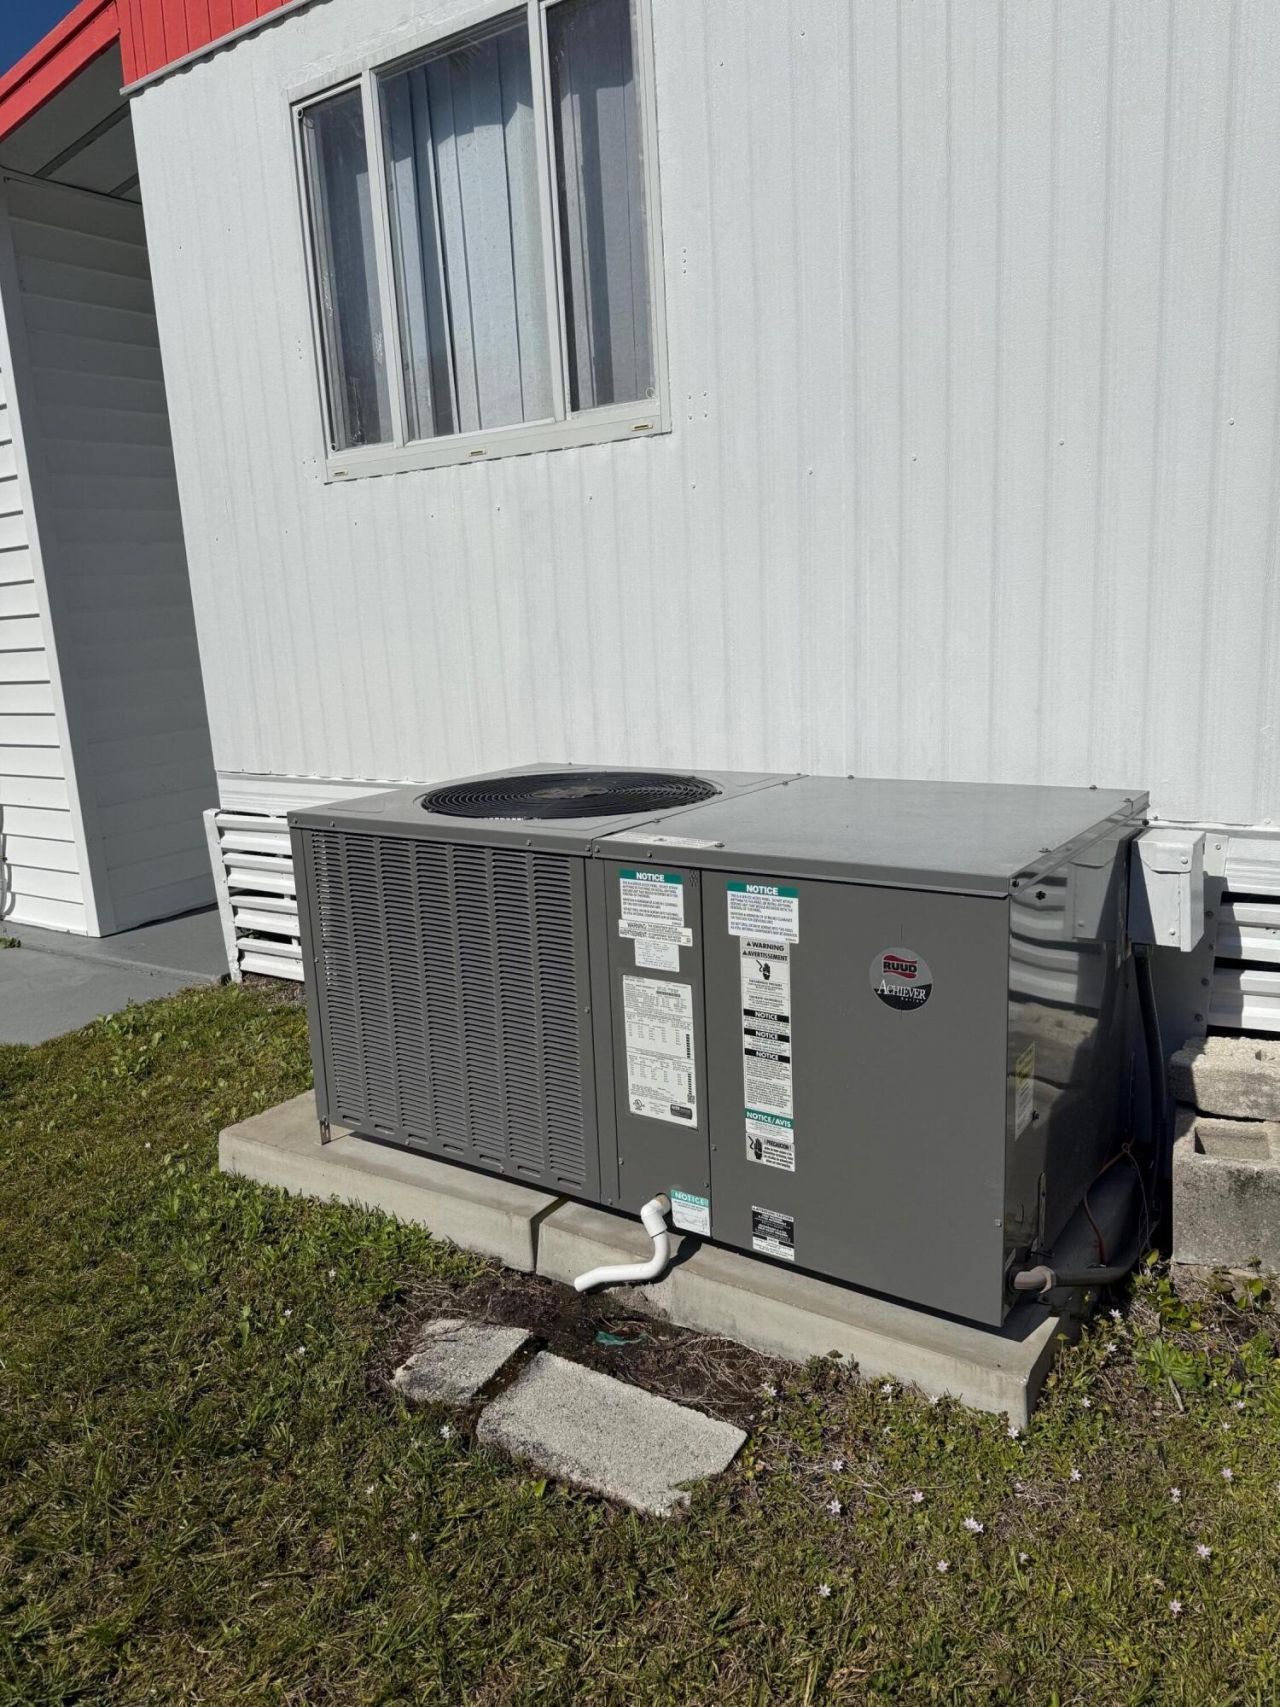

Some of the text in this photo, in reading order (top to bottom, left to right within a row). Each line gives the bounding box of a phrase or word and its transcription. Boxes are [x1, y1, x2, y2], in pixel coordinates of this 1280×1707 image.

[636, 872, 665, 882] NOTICE
[746, 884, 779, 895] NOTICE
[752, 941, 785, 952] WARNING
[883, 961, 918, 973] RUUD
[755, 1011, 778, 1021] NOTICE
[755, 1030, 778, 1040] NOTICE
[756, 1050, 779, 1061] NOTICE
[746, 1111, 792, 1128] NOTICE/AVIS
[674, 1191, 705, 1205] NOTICE
